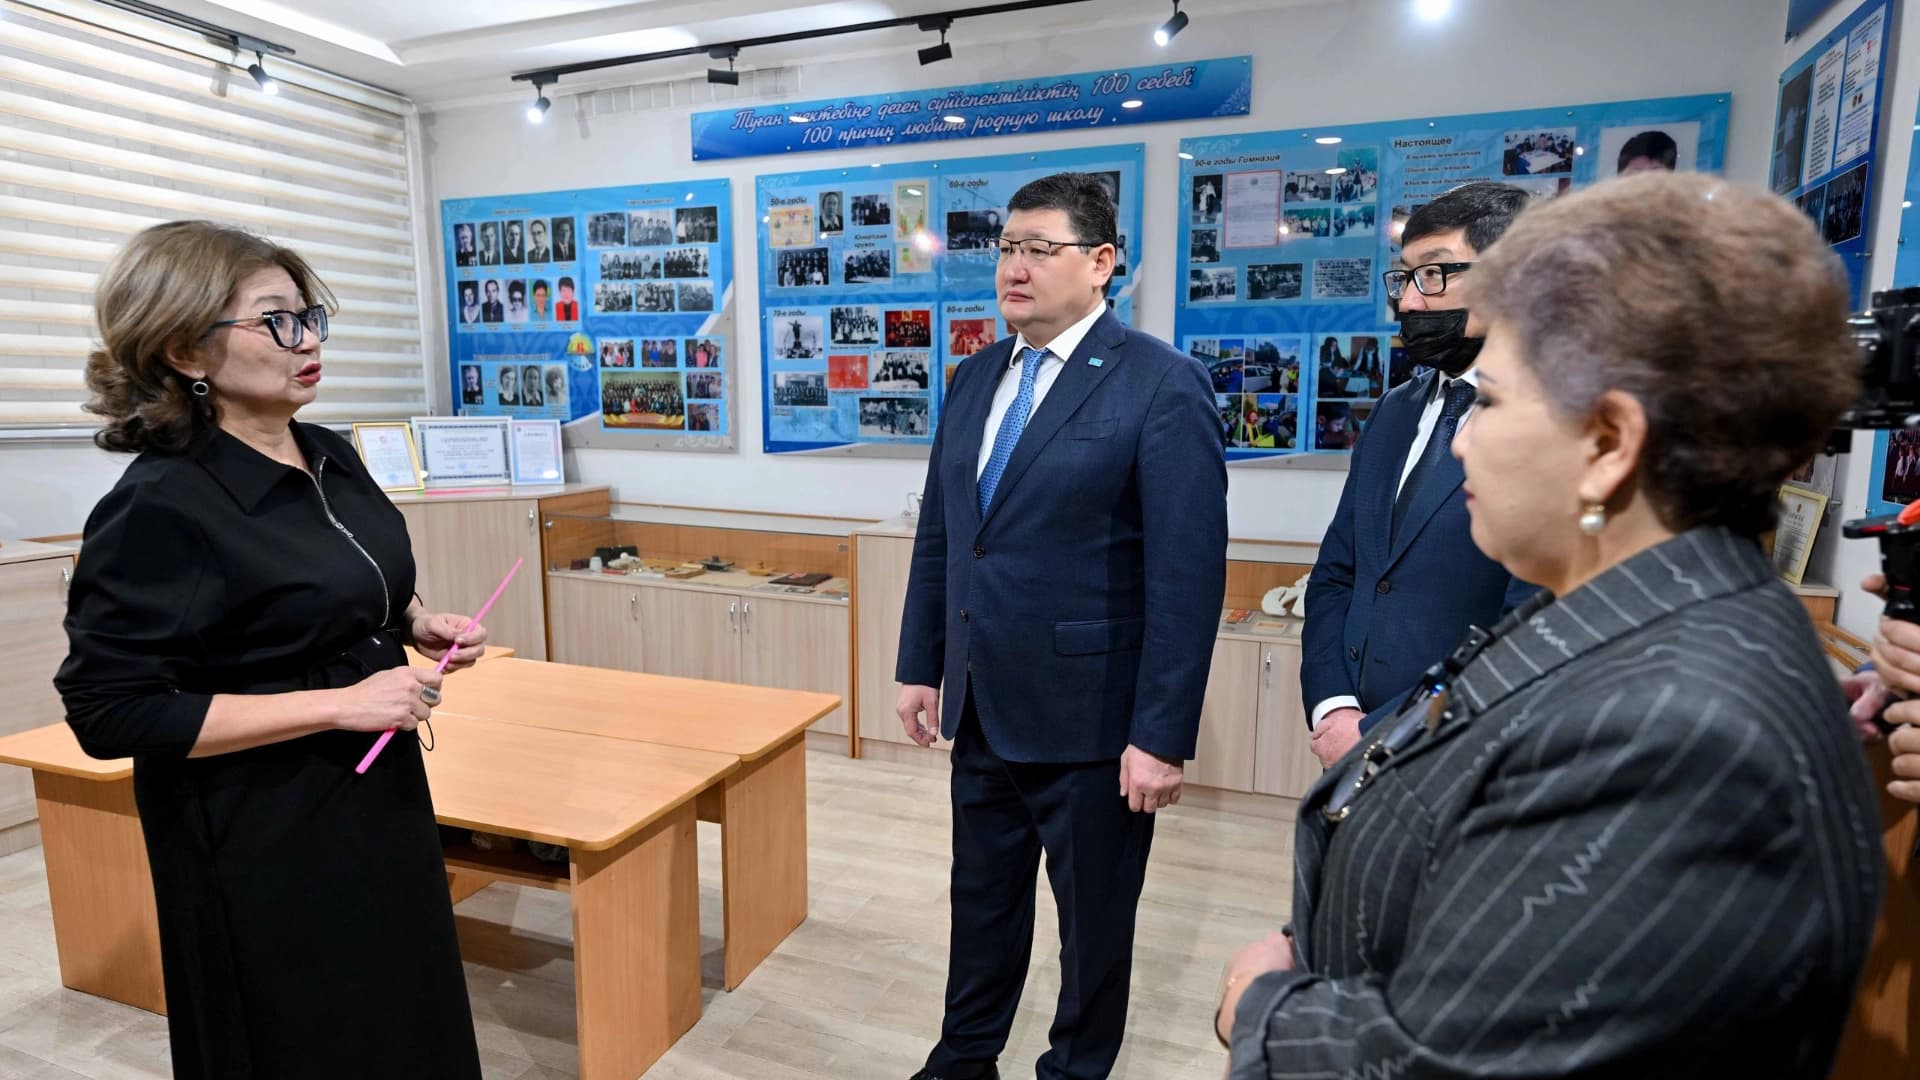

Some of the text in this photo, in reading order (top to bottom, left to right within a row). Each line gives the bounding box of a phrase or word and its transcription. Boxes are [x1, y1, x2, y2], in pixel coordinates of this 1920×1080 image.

[878, 101, 920, 119] деген
[1091, 74, 1129, 96] 100
[1137, 67, 1195, 90] себебі
[802, 126, 833, 145] 100
[838, 125, 894, 146] причин
[971, 113, 1039, 135] родную
[1047, 107, 1104, 129] школу
[1394, 137, 1453, 148] Настоящее
[1238, 153, 1281, 164] Гимназия
